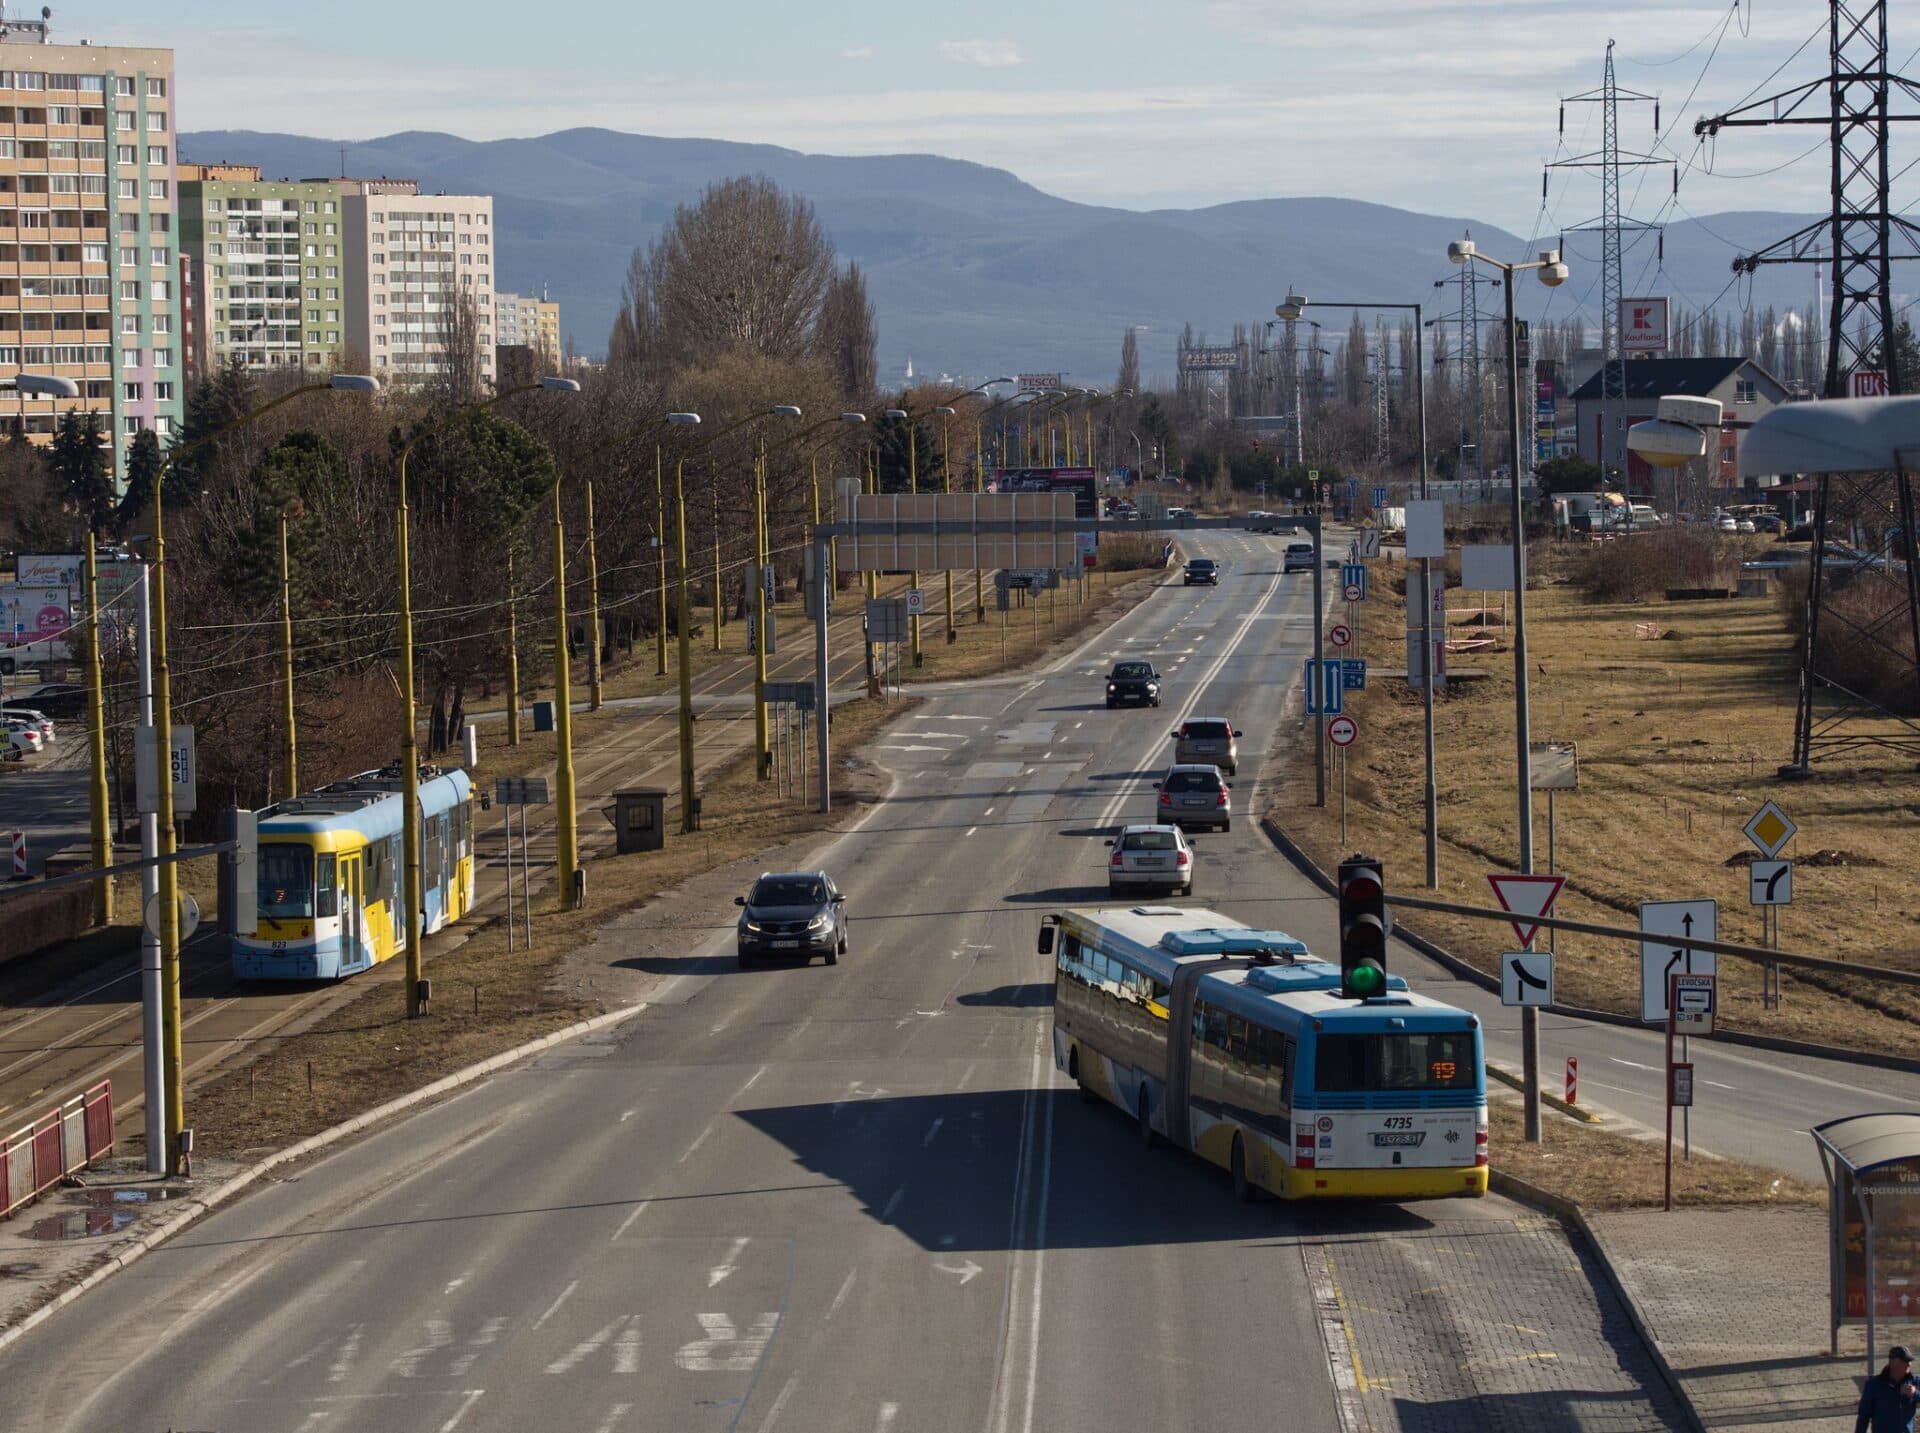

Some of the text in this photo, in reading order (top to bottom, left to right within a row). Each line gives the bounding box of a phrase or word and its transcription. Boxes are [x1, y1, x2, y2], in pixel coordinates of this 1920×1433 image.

[1624, 333, 1662, 341] Kaufland
[1021, 377, 1057, 387] TESCO
[272, 941, 287, 949] 823
[1384, 1117, 1412, 1129] 4735
